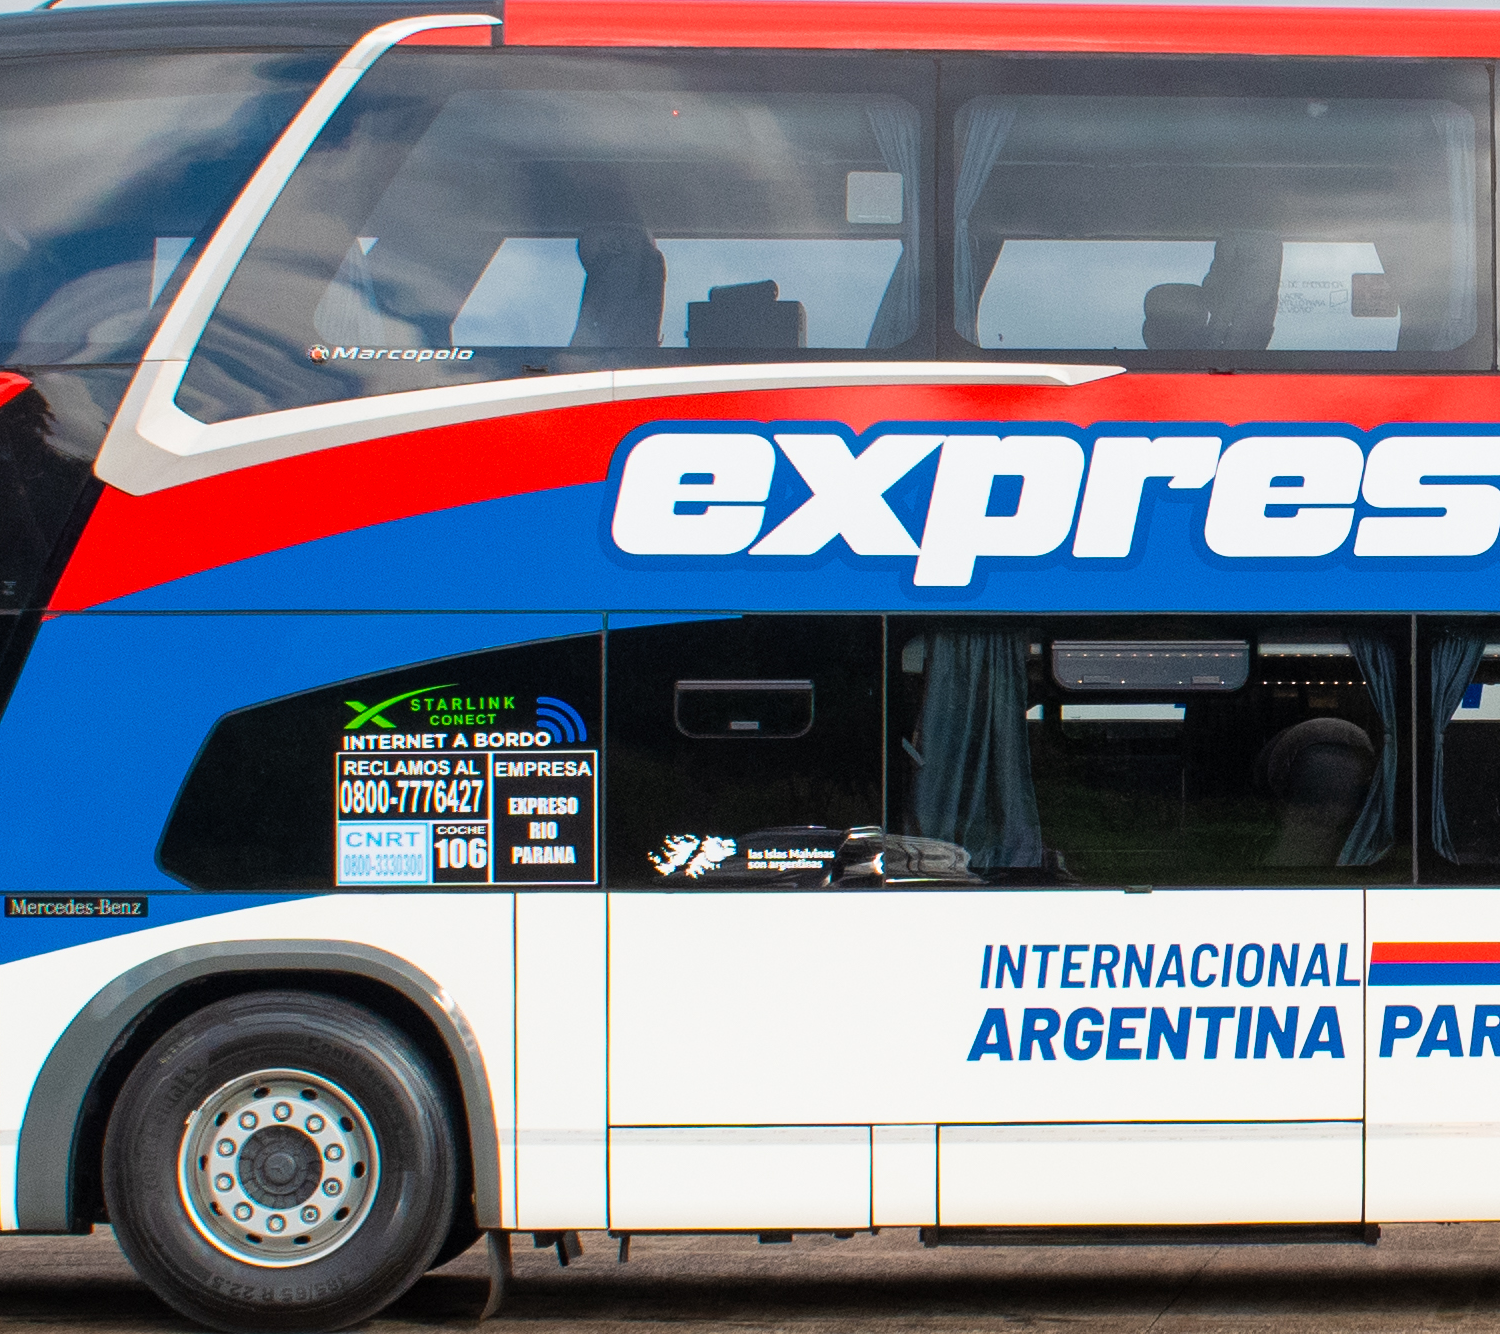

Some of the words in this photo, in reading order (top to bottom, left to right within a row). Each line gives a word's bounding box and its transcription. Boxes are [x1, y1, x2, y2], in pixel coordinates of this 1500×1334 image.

[332, 346, 475, 363] Marcopolo
[410, 695, 516, 712] STARLINK
[429, 713, 498, 727] CONECT
[343, 733, 448, 751] INTERNET
[453, 733, 469, 748] A
[474, 731, 552, 749] BORDO
[343, 759, 451, 776] RECLAMOS
[455, 759, 481, 776] AL
[494, 760, 593, 778] EMPRESA
[340, 779, 485, 814] 0800-7776427
[508, 796, 579, 815] EXPRESO
[436, 825, 487, 835] COCHE
[528, 821, 559, 840] RIO
[345, 831, 421, 848] CNRT
[434, 837, 488, 869] 106
[511, 845, 577, 865] PARANA
[788, 847, 836, 859] Malvinas
[747, 860, 768, 870] son
[767, 858, 824, 871] argentinas
[9, 898, 142, 916] Mercedes-Benz
[979, 943, 1363, 990] INTERNACIONAL
[966, 1005, 1347, 1062] ARGENTINA
